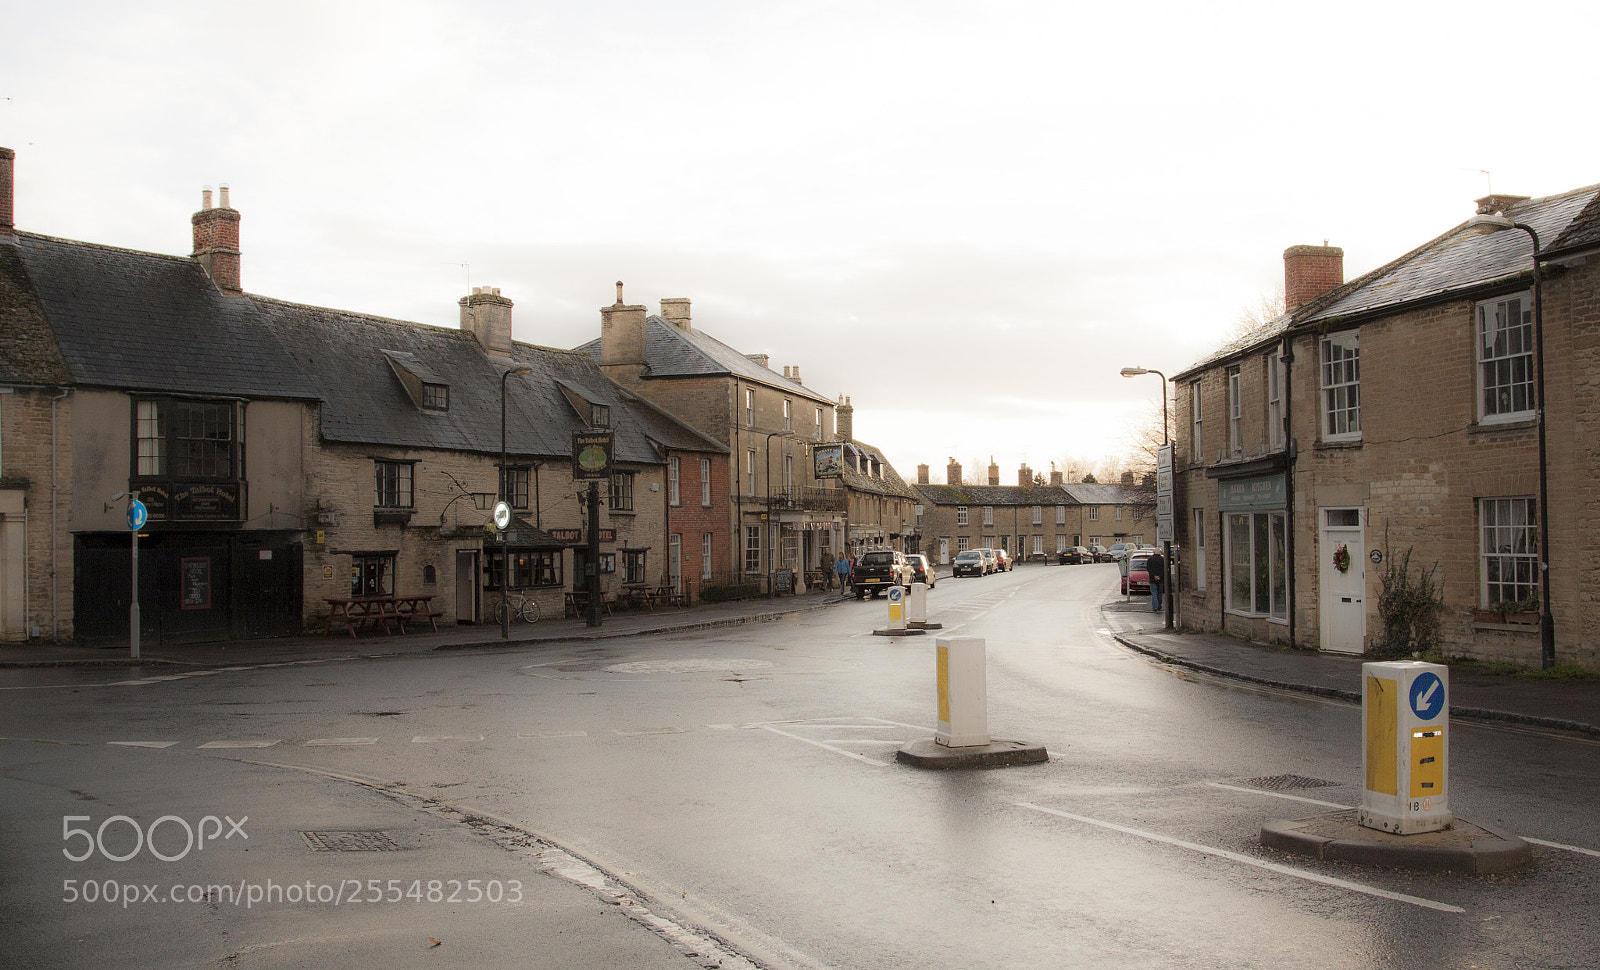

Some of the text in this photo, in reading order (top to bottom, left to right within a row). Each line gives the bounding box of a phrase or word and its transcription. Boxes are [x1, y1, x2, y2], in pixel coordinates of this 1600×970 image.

[190, 485, 214, 495] Talbot
[215, 488, 235, 503] Hotel
[552, 530, 613, 541] TALBOT OTEL
